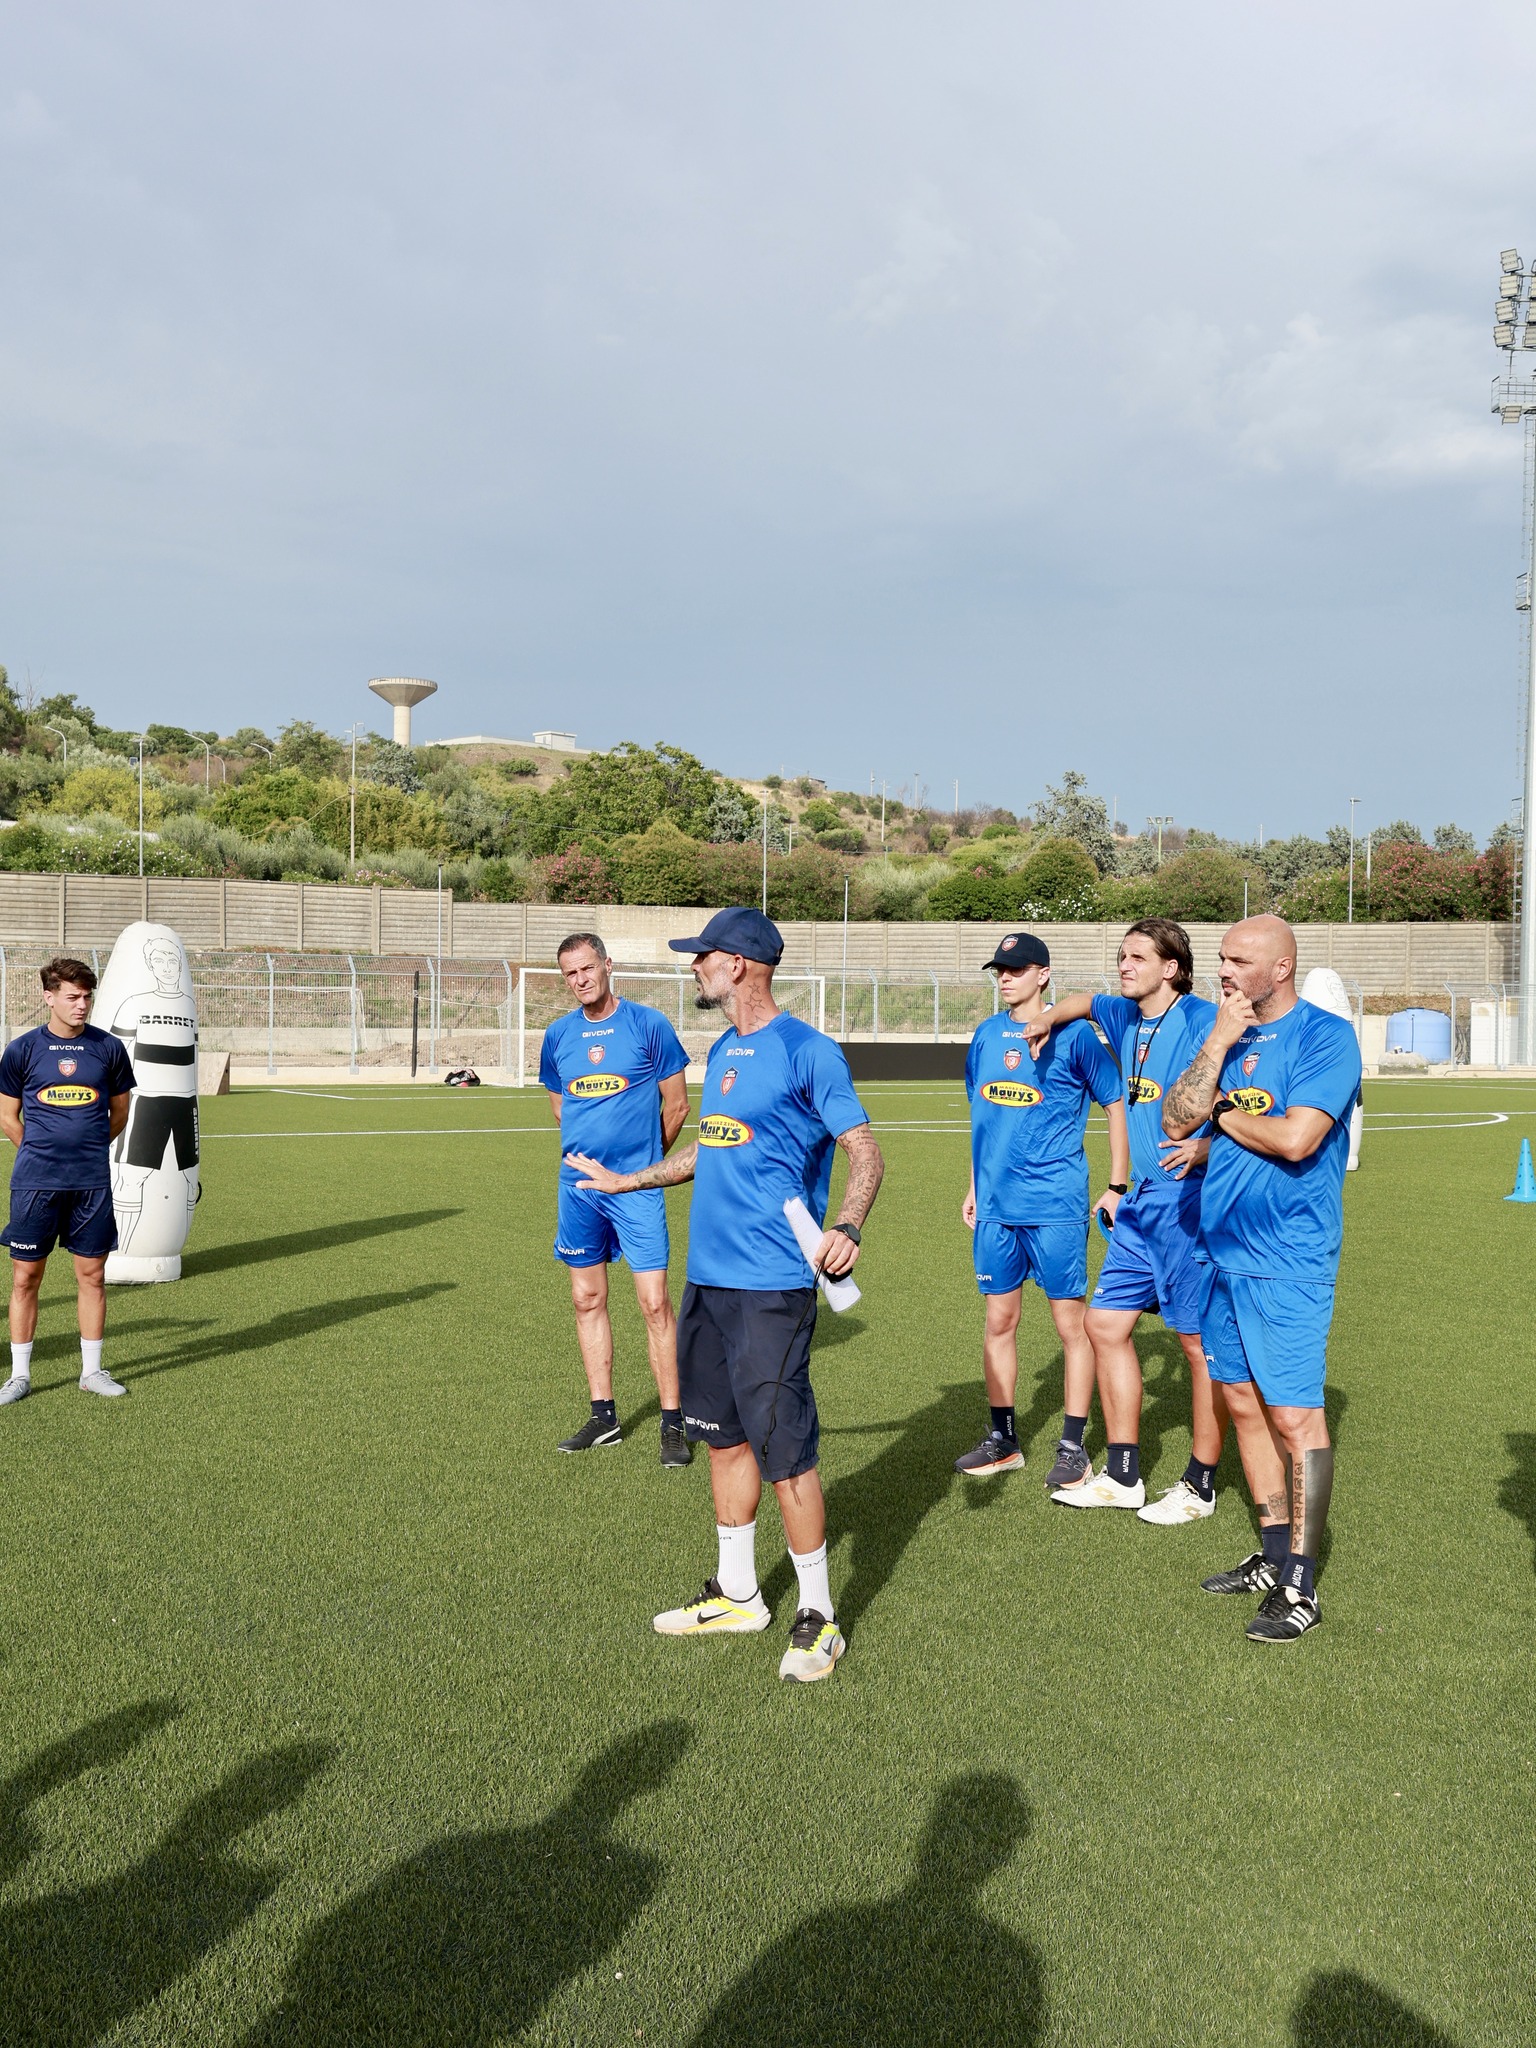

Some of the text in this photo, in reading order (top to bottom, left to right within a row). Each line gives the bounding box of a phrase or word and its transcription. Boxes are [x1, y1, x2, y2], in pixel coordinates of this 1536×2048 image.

[139, 1015, 195, 1028] BARRET
[582, 1028, 614, 1038] GIVOVA
[1238, 1033, 1278, 1044] GIVOVA
[685, 1416, 720, 1431] GIVOVA
[1122, 1451, 1131, 1473] GIVOVA
